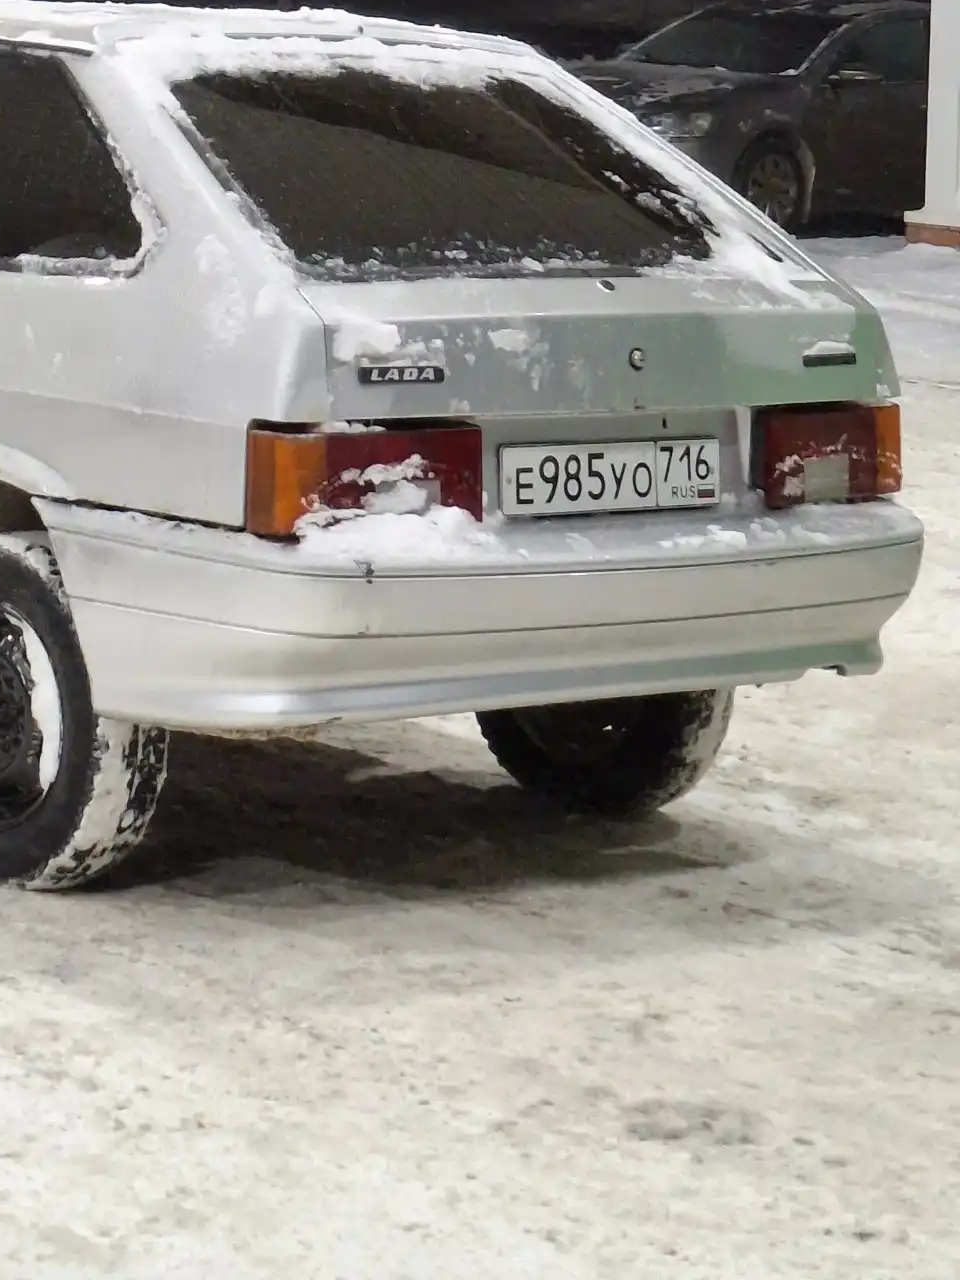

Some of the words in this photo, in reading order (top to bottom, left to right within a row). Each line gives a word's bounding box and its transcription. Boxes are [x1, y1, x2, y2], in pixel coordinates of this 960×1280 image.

[370, 367, 435, 381] LADA
[659, 445, 711, 483] 716
[671, 487, 696, 499] RUS
